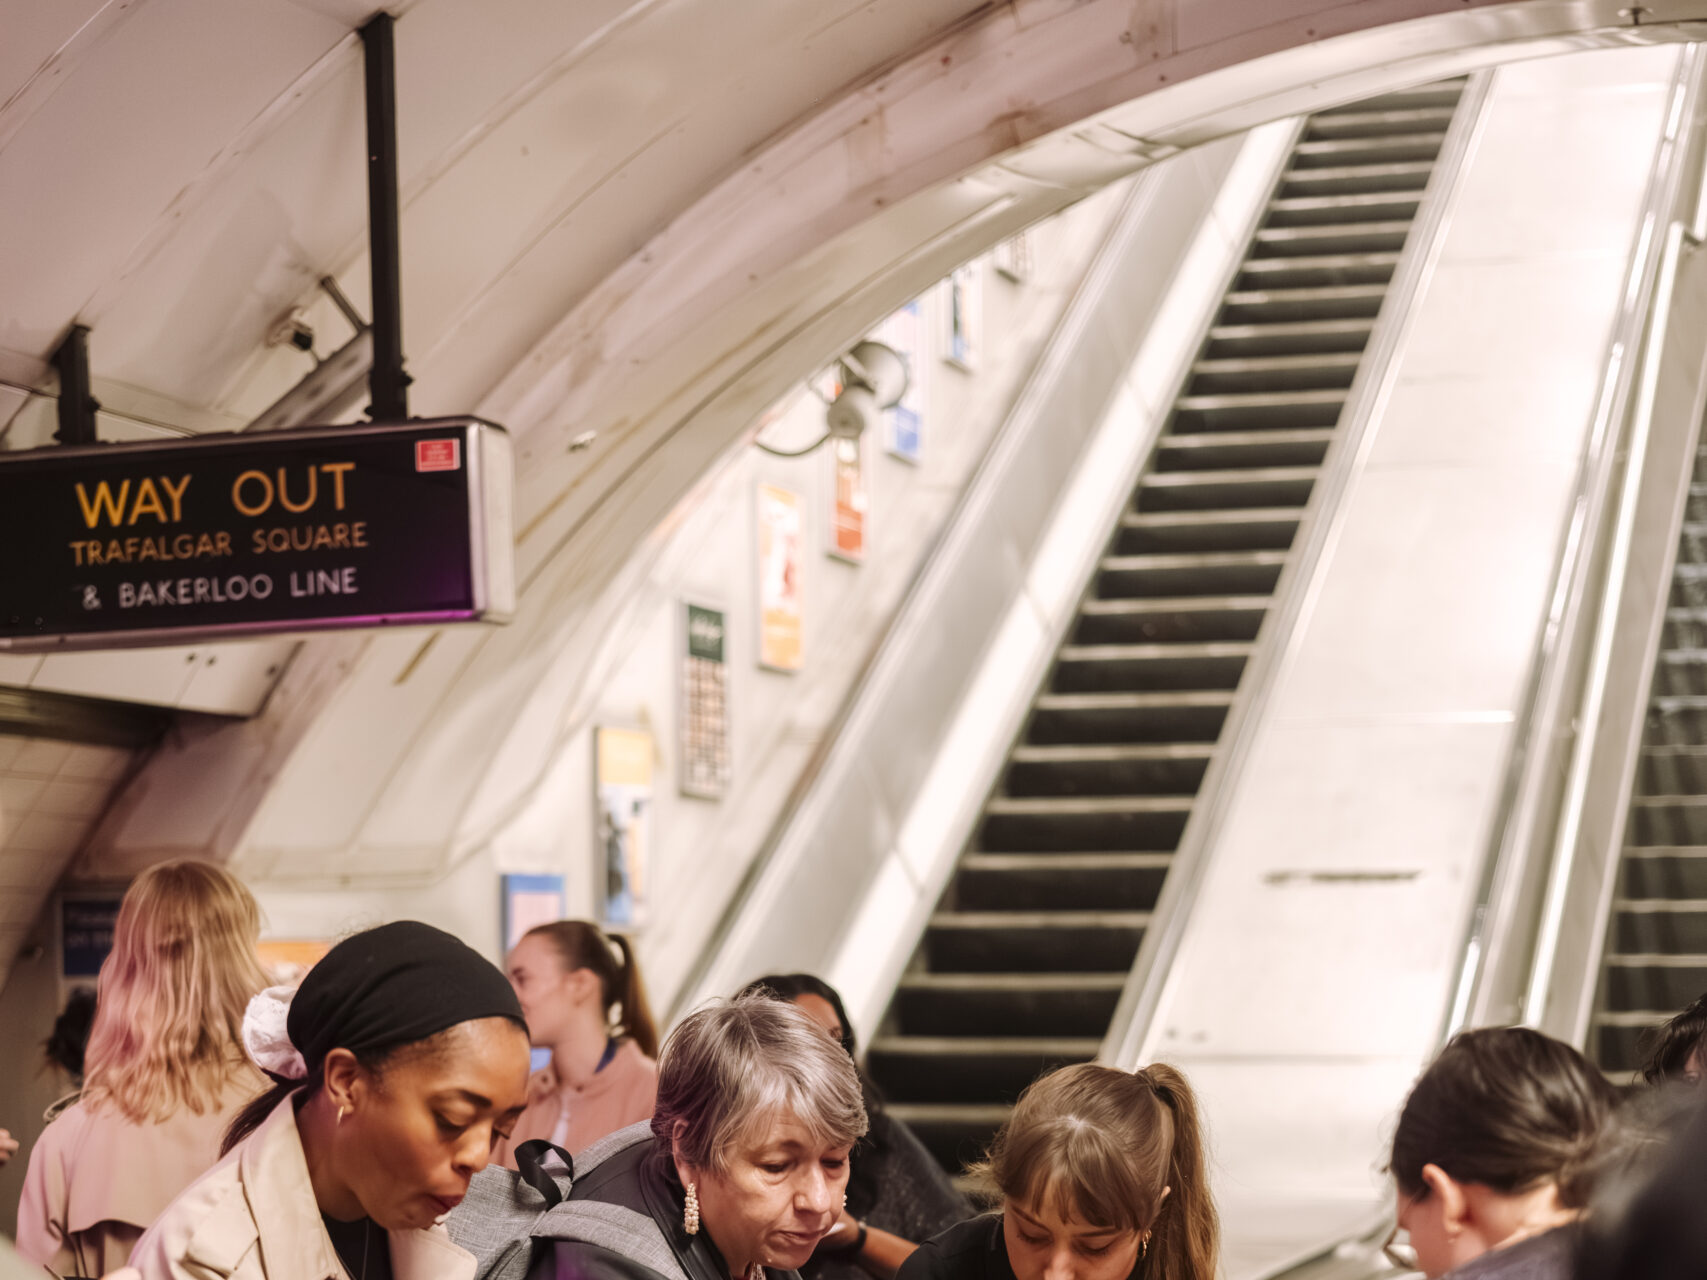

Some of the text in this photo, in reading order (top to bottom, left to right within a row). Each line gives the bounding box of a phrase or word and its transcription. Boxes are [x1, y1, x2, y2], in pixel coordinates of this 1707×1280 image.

[74, 461, 356, 528] WAY OUT
[69, 521, 369, 566] TRAFALGAR SQUARE
[83, 566, 360, 610] & BAKERLOO LINE
